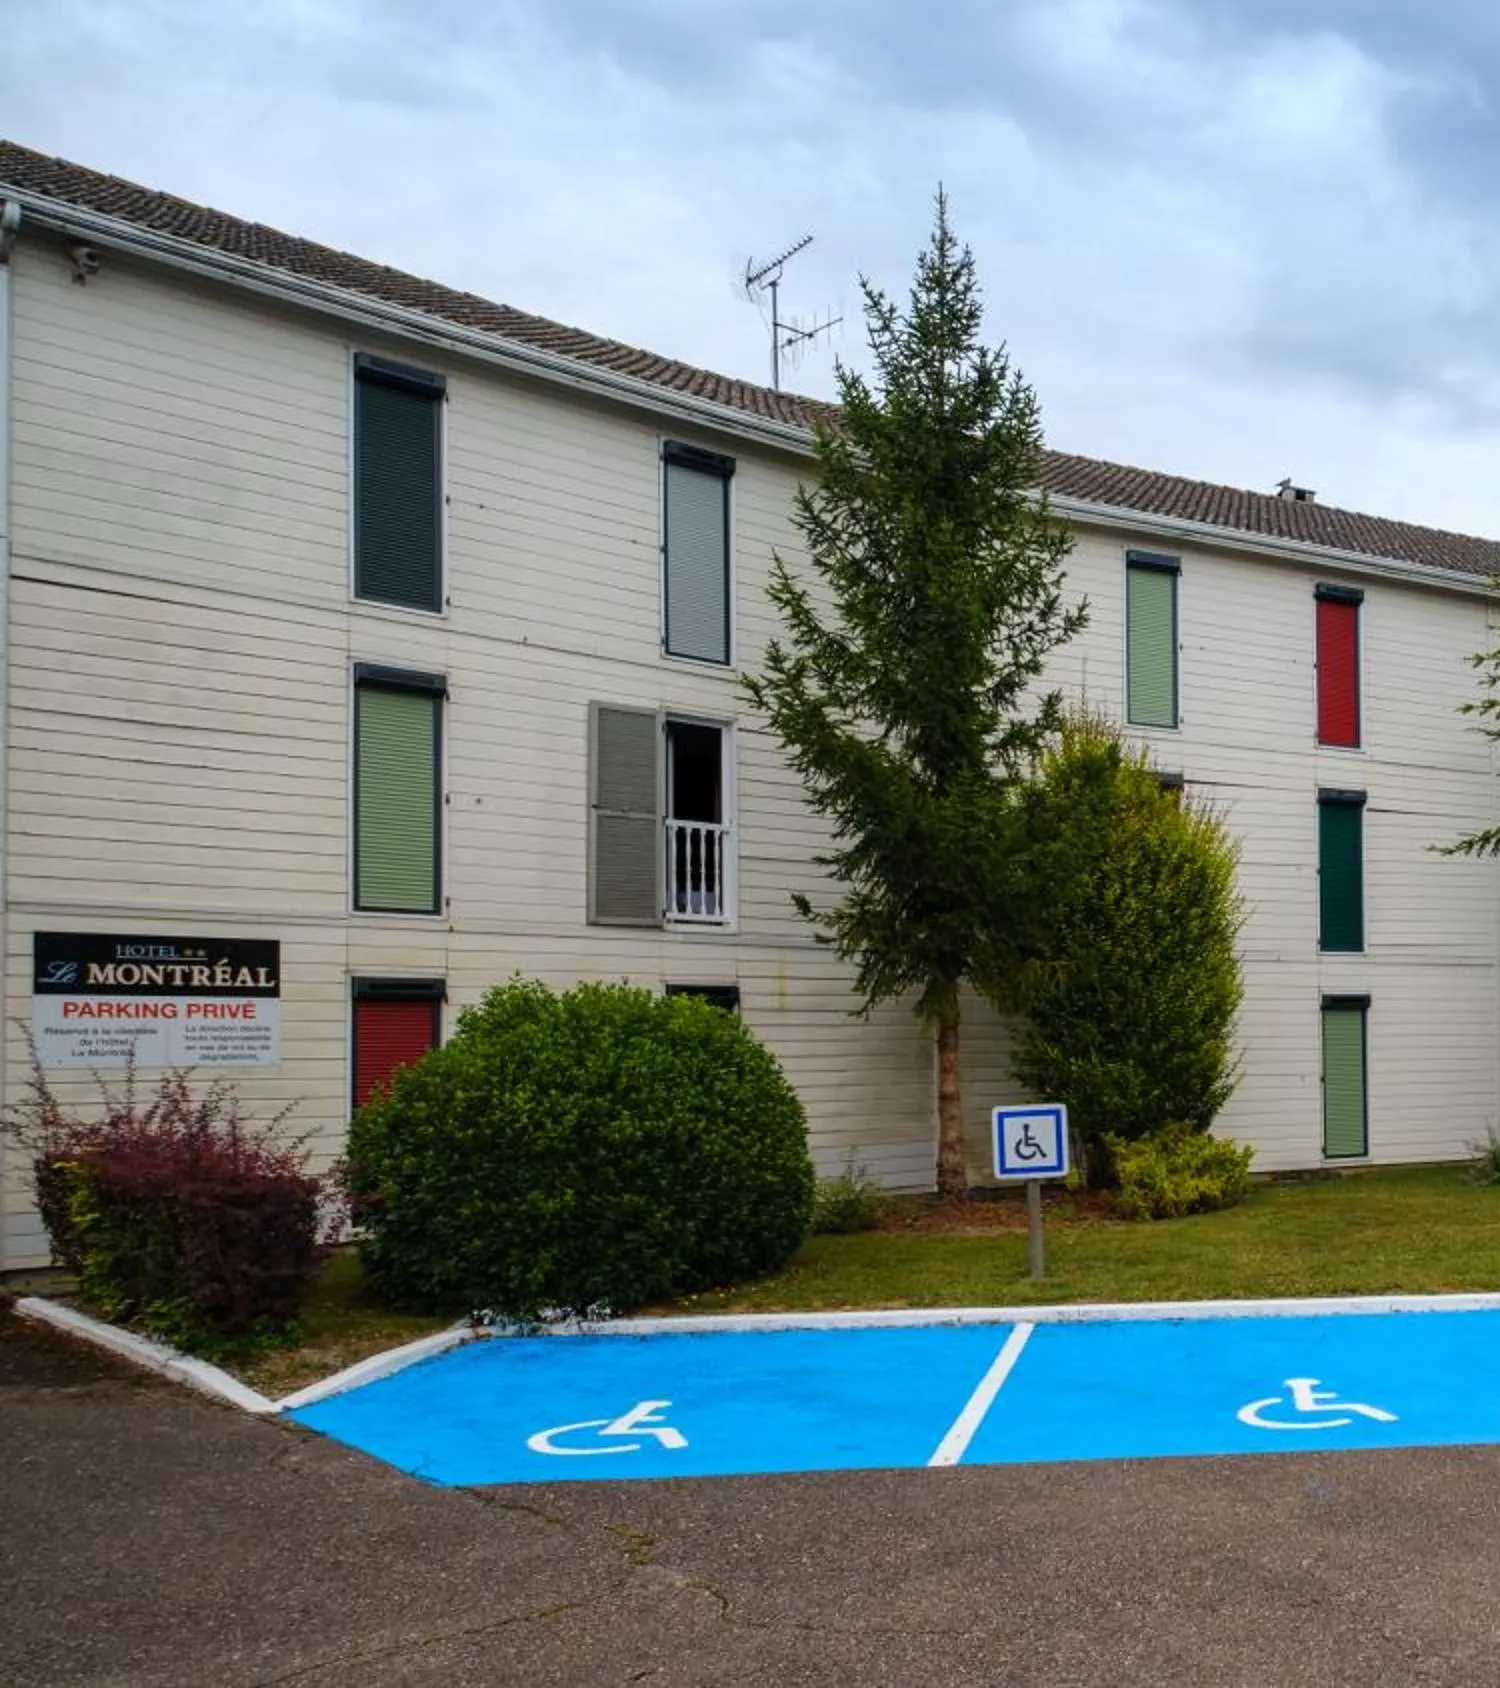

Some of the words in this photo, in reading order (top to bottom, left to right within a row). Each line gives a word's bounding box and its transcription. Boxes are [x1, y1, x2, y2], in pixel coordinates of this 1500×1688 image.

[38, 961, 78, 983] Le
[86, 957, 276, 988] MONTRÉAL
[63, 1001, 178, 1019] PARKING
[187, 1000, 257, 1019] PRIVÉ
